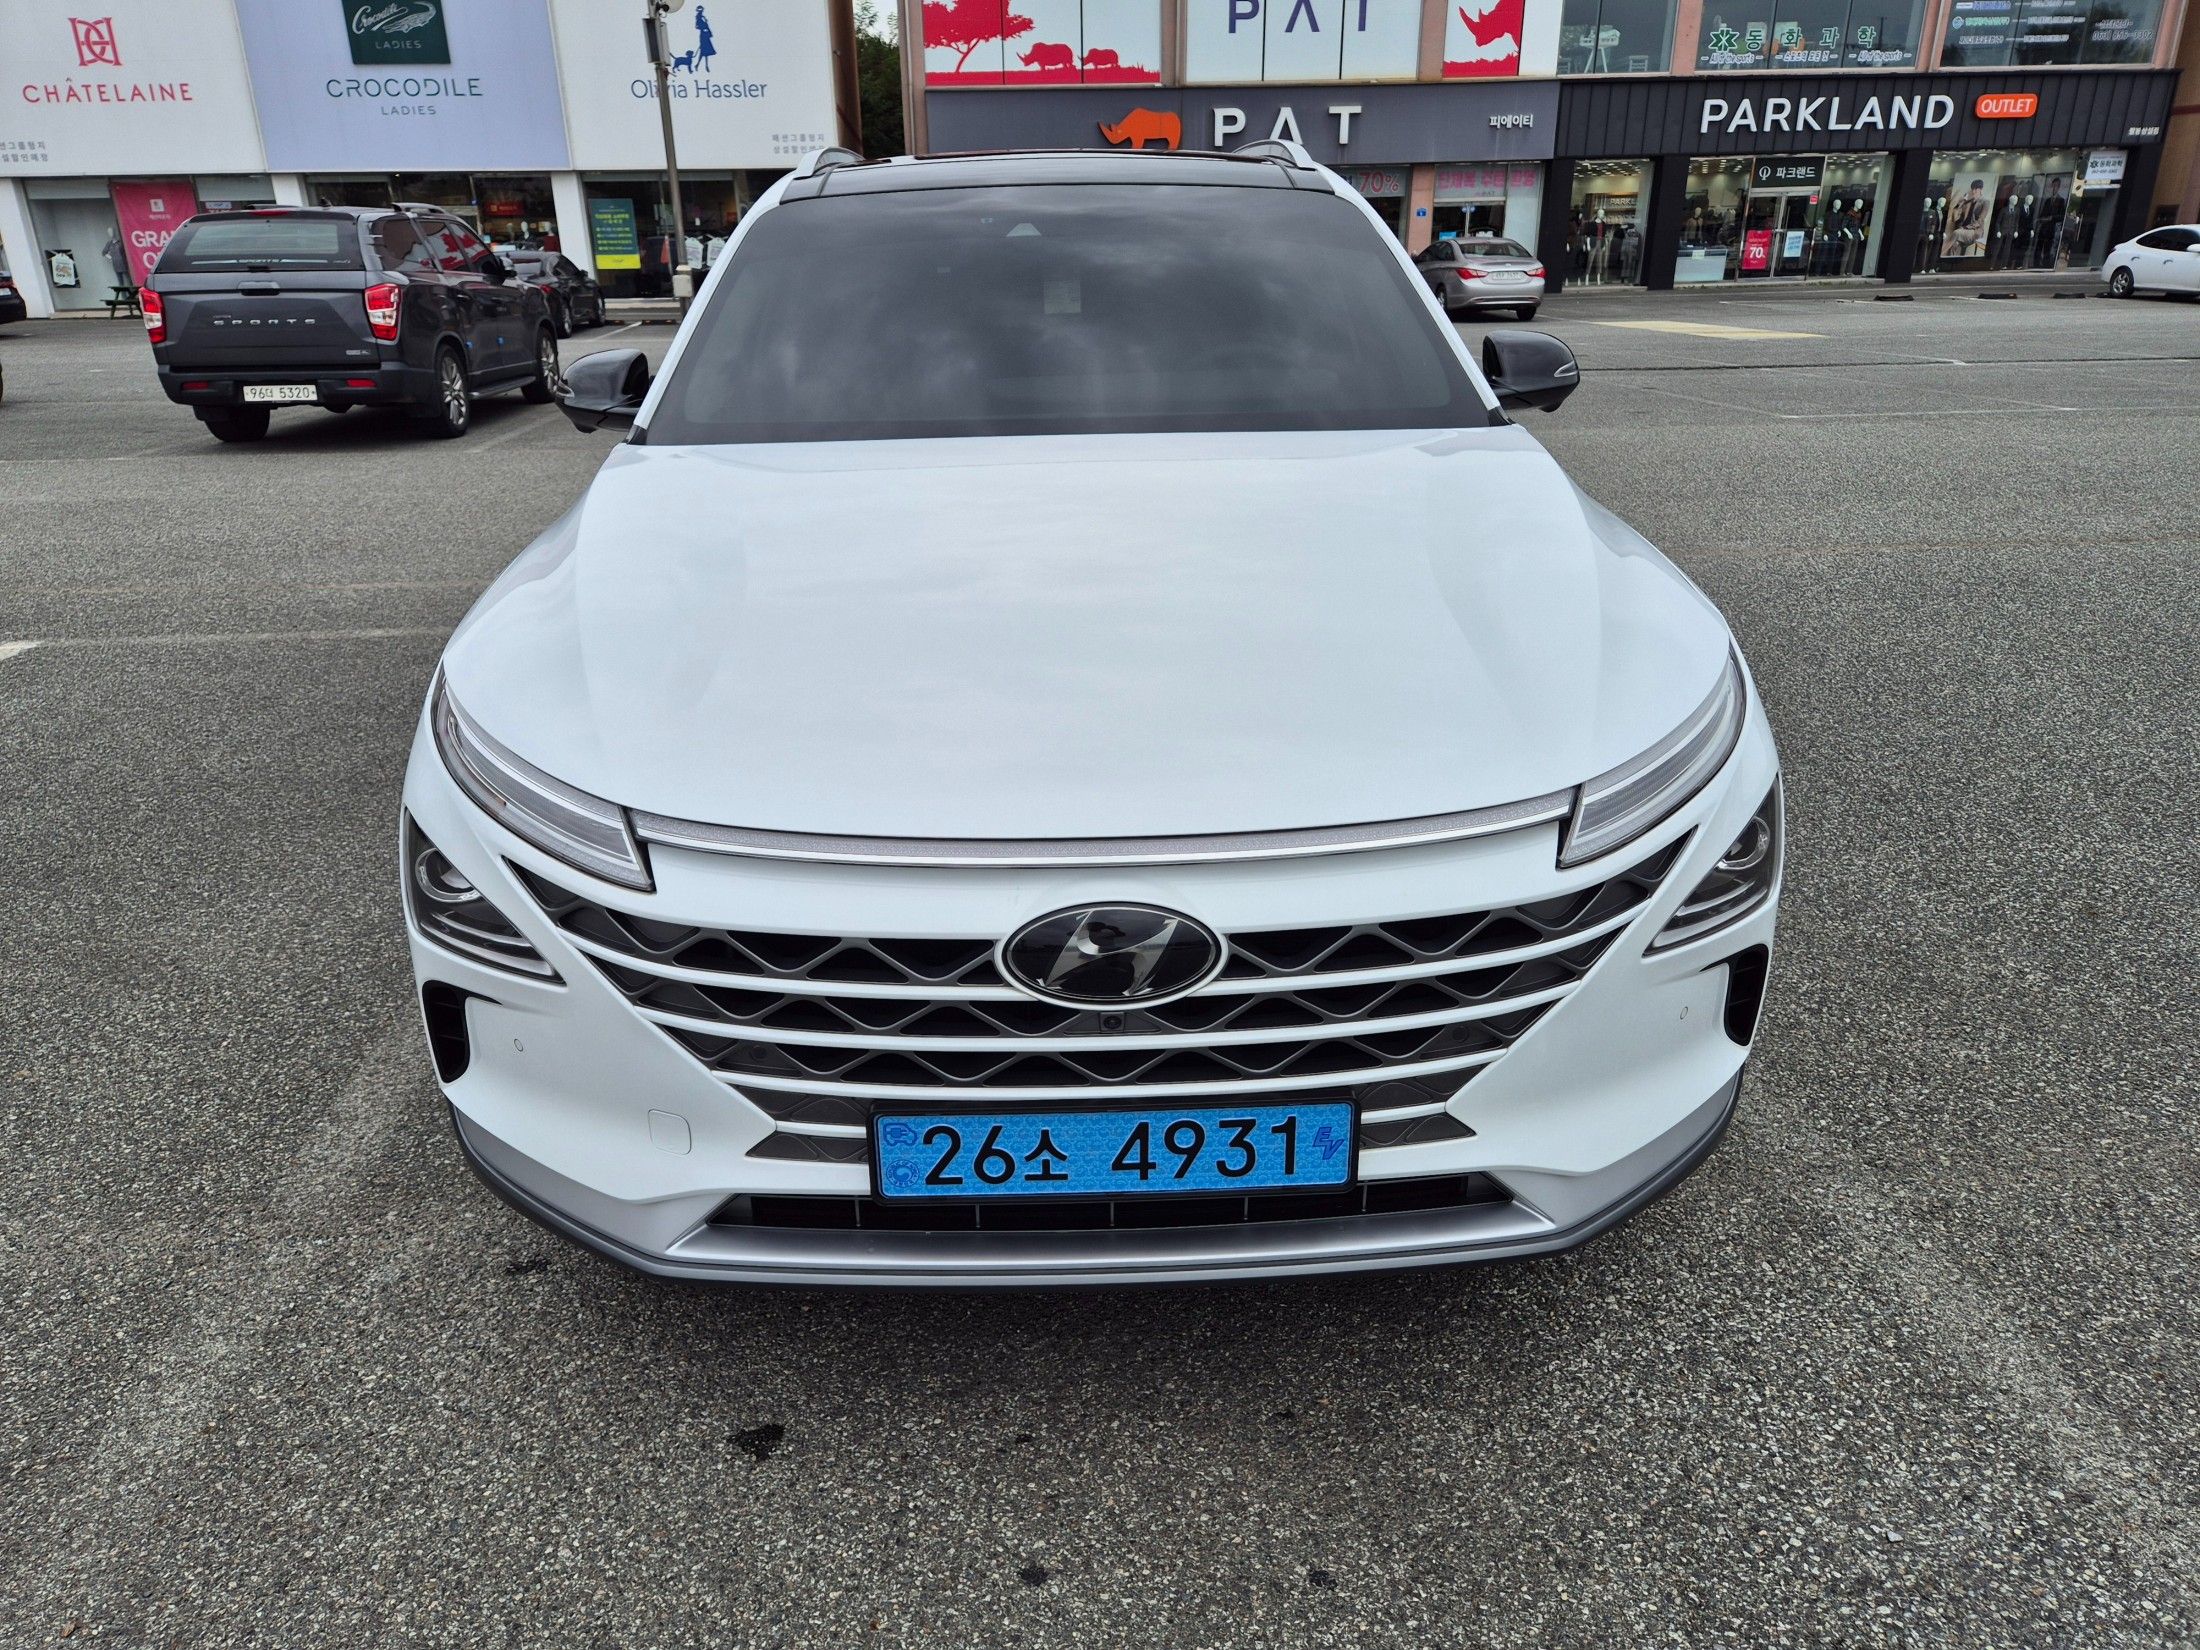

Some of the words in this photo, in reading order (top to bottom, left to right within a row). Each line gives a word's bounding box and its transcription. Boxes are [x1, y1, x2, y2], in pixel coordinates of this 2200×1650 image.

[375, 40, 421, 49] LADIES
[22, 77, 193, 103] CHÂTELAINE
[326, 78, 483, 97] CROCODILE
[694, 79, 767, 98] Hassler
[381, 105, 437, 115] LADIES
[1700, 94, 1954, 133] PARKLAND
[1981, 98, 2034, 114] OUTLET
[1213, 105, 1362, 147] PAT
[1489, 114, 1534, 128] 피에이티
[1775, 166, 1816, 178] 파크랜드
[1359, 171, 1399, 193] 70%
[131, 230, 176, 247] GRA
[279, 387, 310, 399] 5320
[922, 1124, 1069, 1186] 26소
[1111, 1115, 1297, 1180] 4931
[1313, 1126, 1344, 1161] EV
